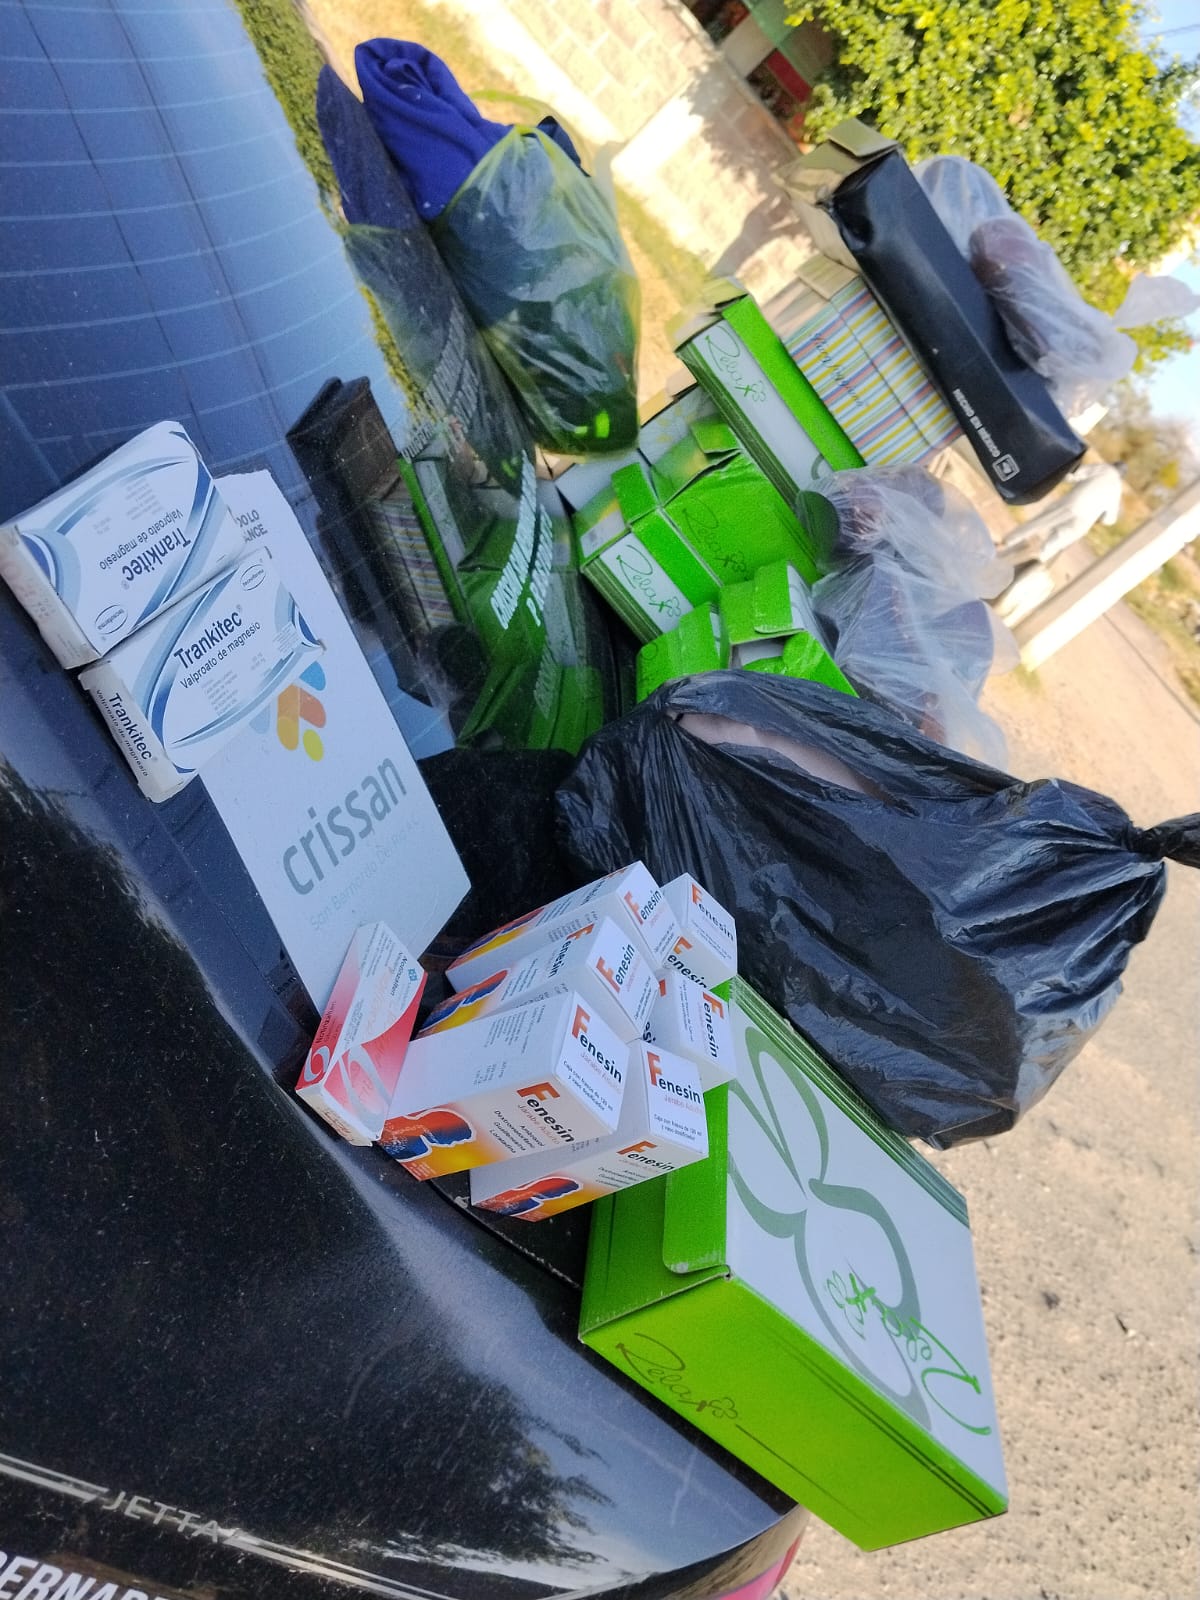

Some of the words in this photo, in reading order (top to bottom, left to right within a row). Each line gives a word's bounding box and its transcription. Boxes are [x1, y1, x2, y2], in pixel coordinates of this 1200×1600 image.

[952, 388, 975, 417] HECHO
[137, 531, 149, 544] de
[149, 508, 184, 536] Valproato
[99, 538, 138, 571] magnesio
[121, 527, 192, 582] Trankitec
[173, 611, 243, 669] Trankitec
[179, 657, 218, 689] Valproato
[217, 649, 228, 662] de
[227, 620, 262, 653] magnesio
[109, 692, 152, 760] Trankitec
[283, 758, 407, 895] crissan
[623, 889, 662, 926] Fenesin
[691, 883, 735, 942] Fenesin
[596, 943, 635, 993] Fenesin
[571, 1003, 622, 1084] Fenesin
[703, 991, 725, 1059] Fenesin
[646, 1050, 702, 1104] Fenesin
[516, 1081, 575, 1143] Fenesin
[616, 1140, 676, 1171] Fenesin
[102, 1490, 219, 1544] JETTA
